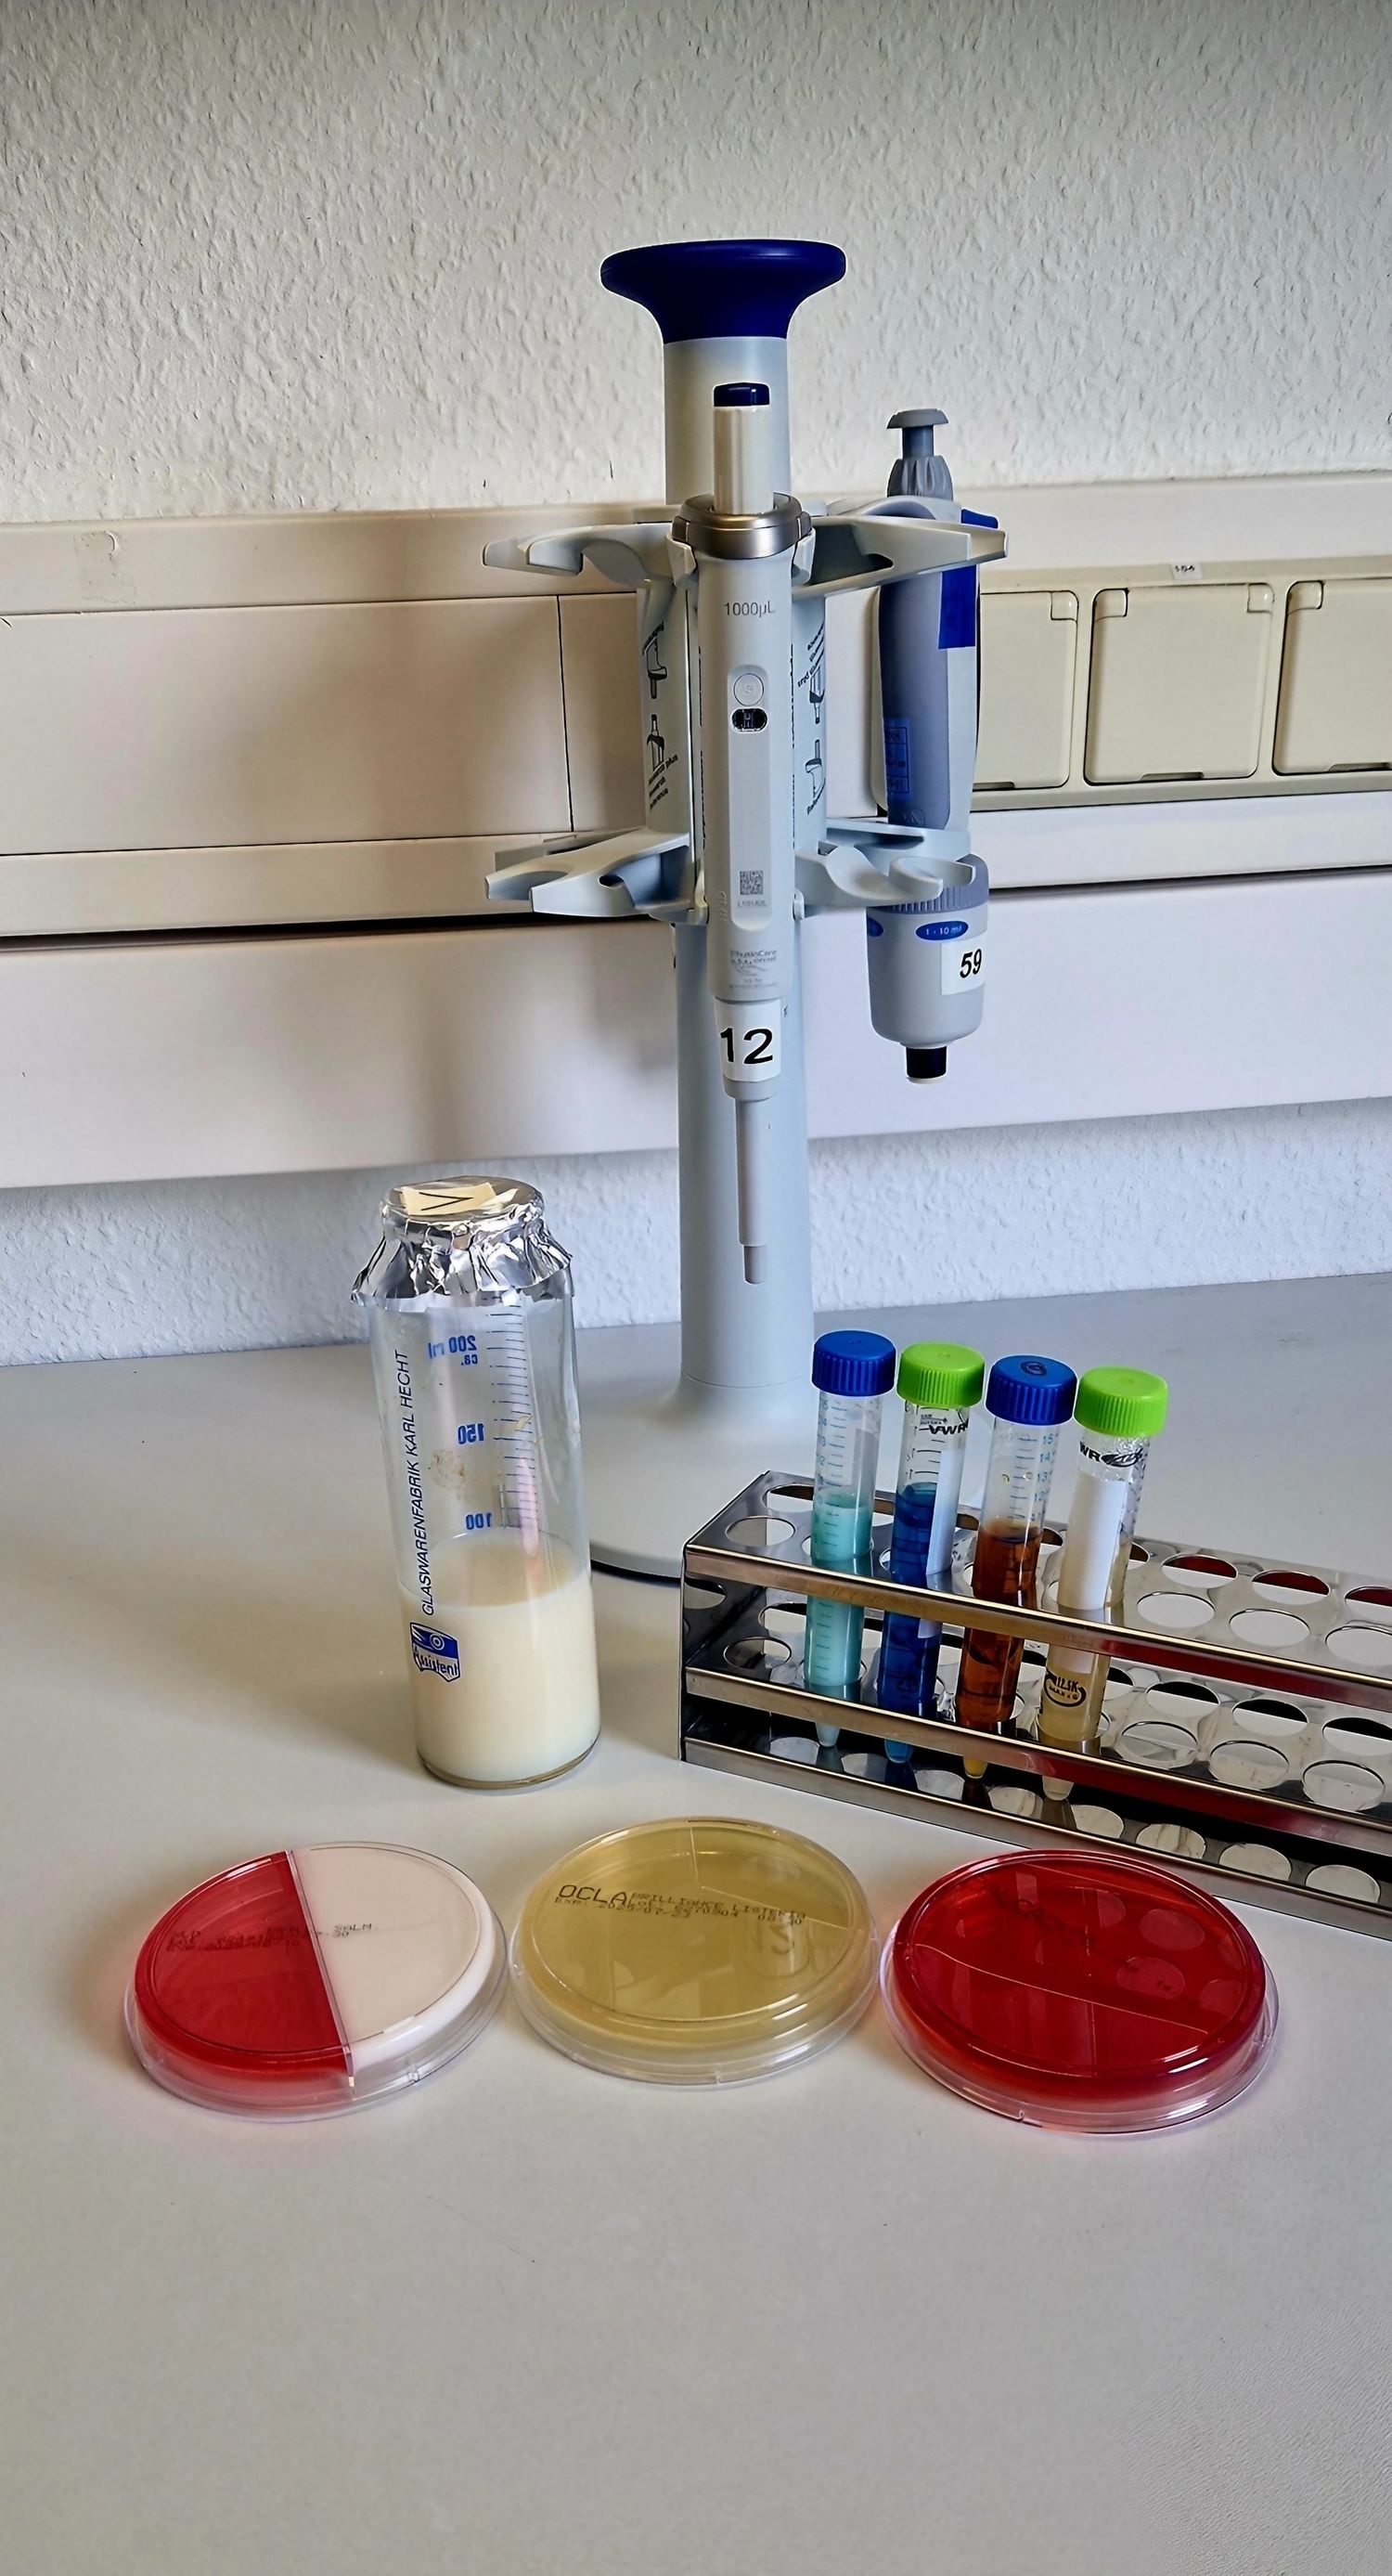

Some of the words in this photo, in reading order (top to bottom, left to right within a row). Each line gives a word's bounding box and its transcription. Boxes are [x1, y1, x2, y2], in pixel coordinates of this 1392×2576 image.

[960, 948, 983, 978] 59
[720, 1027, 773, 1065] 12
[394, 1349, 413, 1408] HECHT
[402, 1413, 419, 1456] KARL
[928, 1423, 967, 1435] VWR
[406, 1459, 434, 1616] GLASWARENFABRIK
[558, 1883, 628, 1906] OCLA
